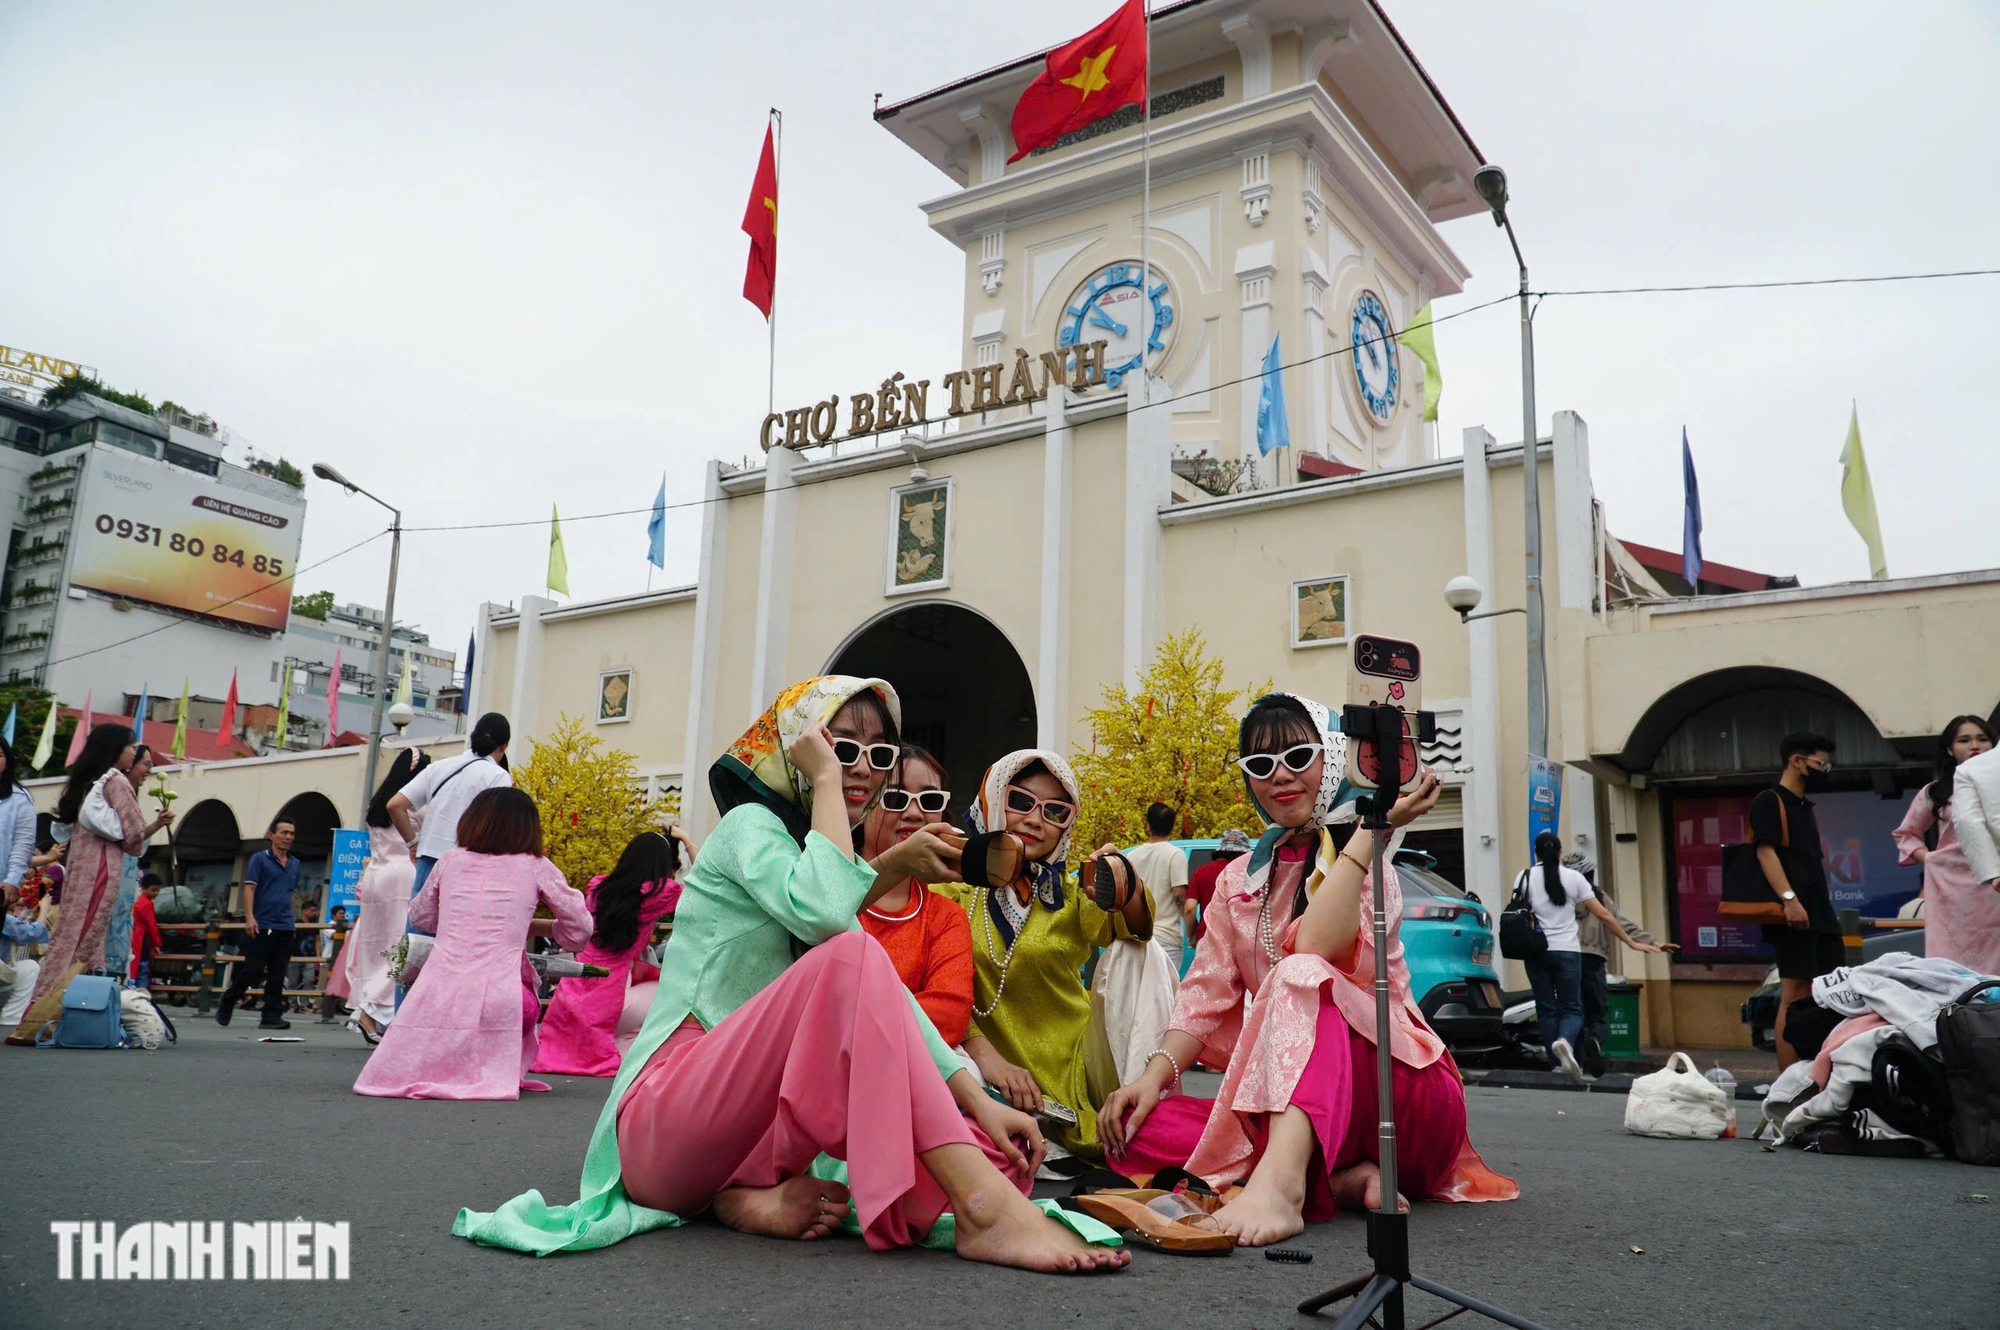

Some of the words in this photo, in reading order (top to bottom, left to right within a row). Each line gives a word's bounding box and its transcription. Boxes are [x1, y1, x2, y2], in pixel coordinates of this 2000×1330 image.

[1105, 263, 1129, 287] 12
[1099, 290, 1139, 307] ASIA
[1157, 305, 1173, 326] 3
[1059, 325, 1075, 345] 9
[1106, 370, 1122, 388] 6
[760, 394, 839, 453] CHỢ
[849, 371, 930, 436] BẾN
[943, 339, 1108, 416] THÀNH
[102, 470, 153, 491] SILVERLAND
[203, 498, 220, 510] LIÊN
[220, 503, 231, 514] HỆ
[232, 506, 261, 521] QUẢNG
[262, 513, 280, 526] CÁO
[95, 514, 162, 547] 0931
[169, 533, 205, 557] 80
[212, 544, 245, 568] 84
[252, 554, 283, 577] 85
[350, 840, 362, 849] GA
[343, 869, 363, 879] MET
[1835, 890, 1865, 900] Bank
